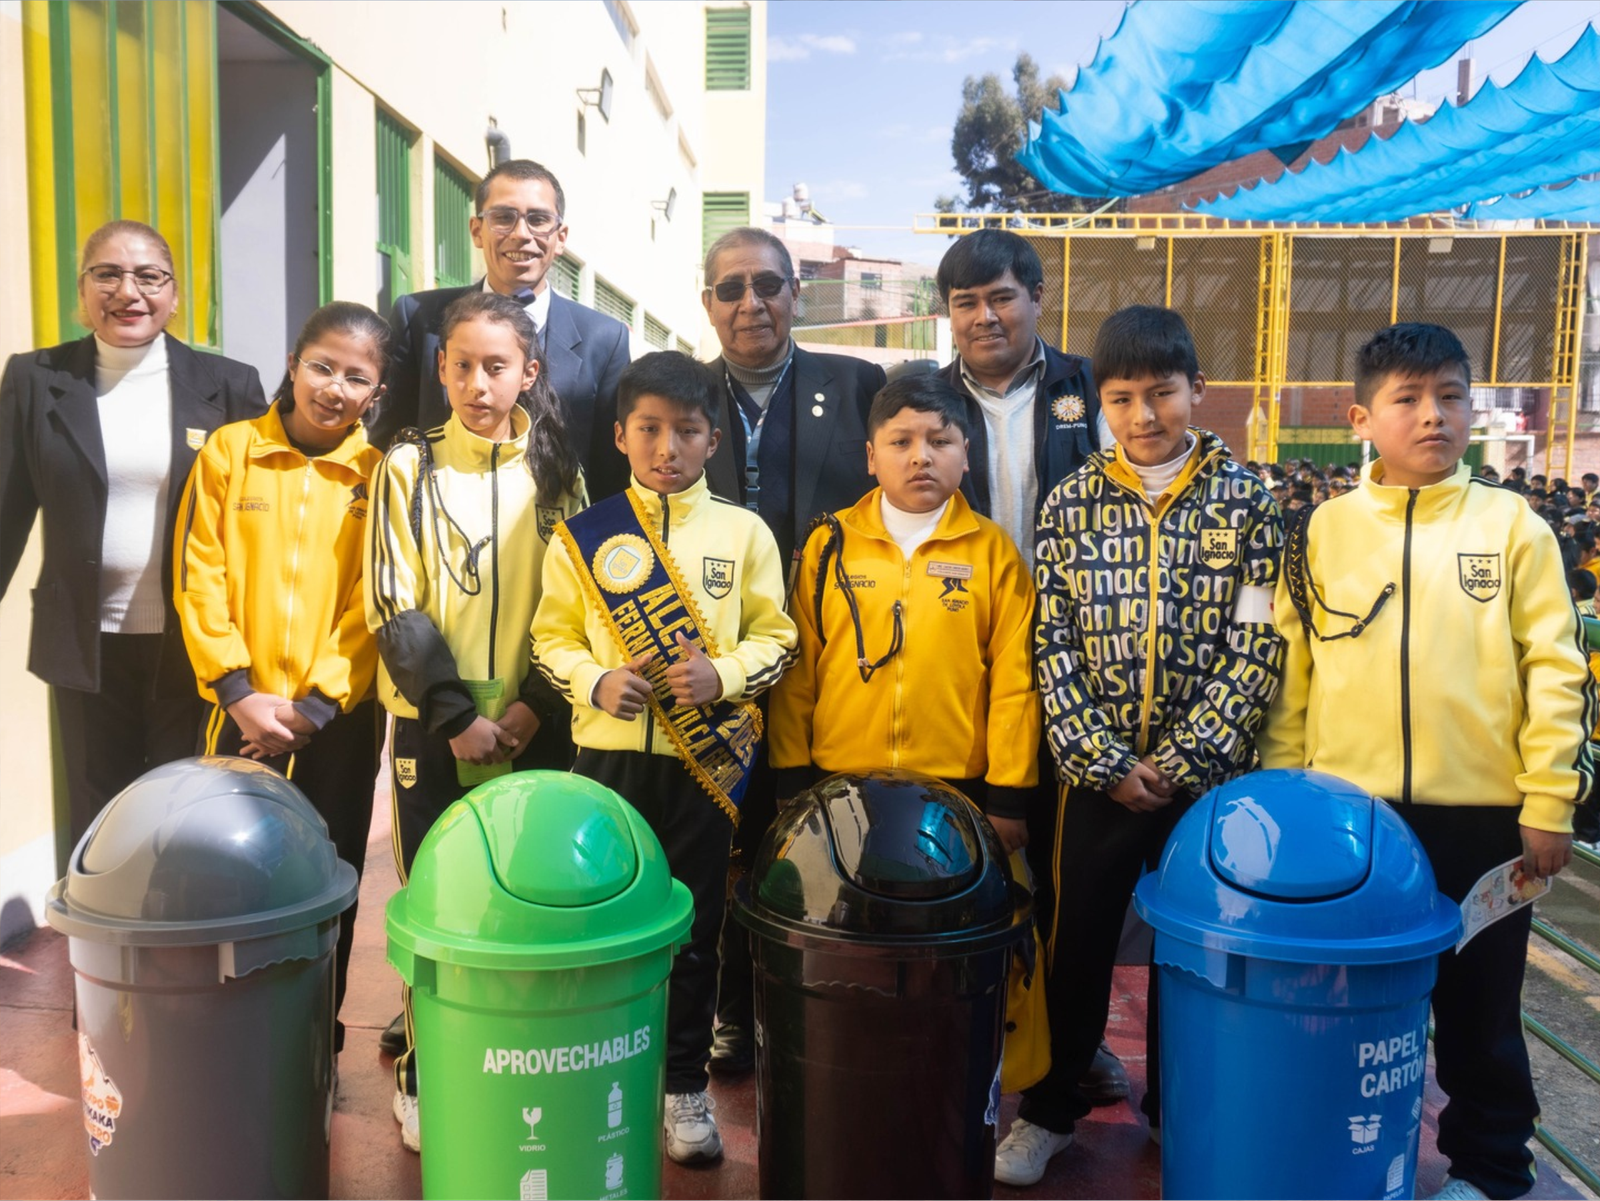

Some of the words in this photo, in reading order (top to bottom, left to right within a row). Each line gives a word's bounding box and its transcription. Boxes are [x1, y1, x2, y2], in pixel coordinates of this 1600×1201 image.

[1209, 538, 1228, 551] San
[1201, 546, 1235, 562] Ignacio
[711, 567, 726, 581] San
[1470, 564, 1492, 578] San
[705, 574, 732, 590] Ignacio
[1463, 573, 1501, 591] Ignacio
[400, 764, 411, 774] San
[482, 1025, 651, 1075] APROVECHABLES
[1358, 1030, 1419, 1068] PAPEL
[1360, 1052, 1425, 1098] CARTÓN
[597, 1127, 631, 1143] PLÁSTICO
[519, 1144, 546, 1153] VIDRIO
[1352, 1145, 1375, 1155] CAJAS
